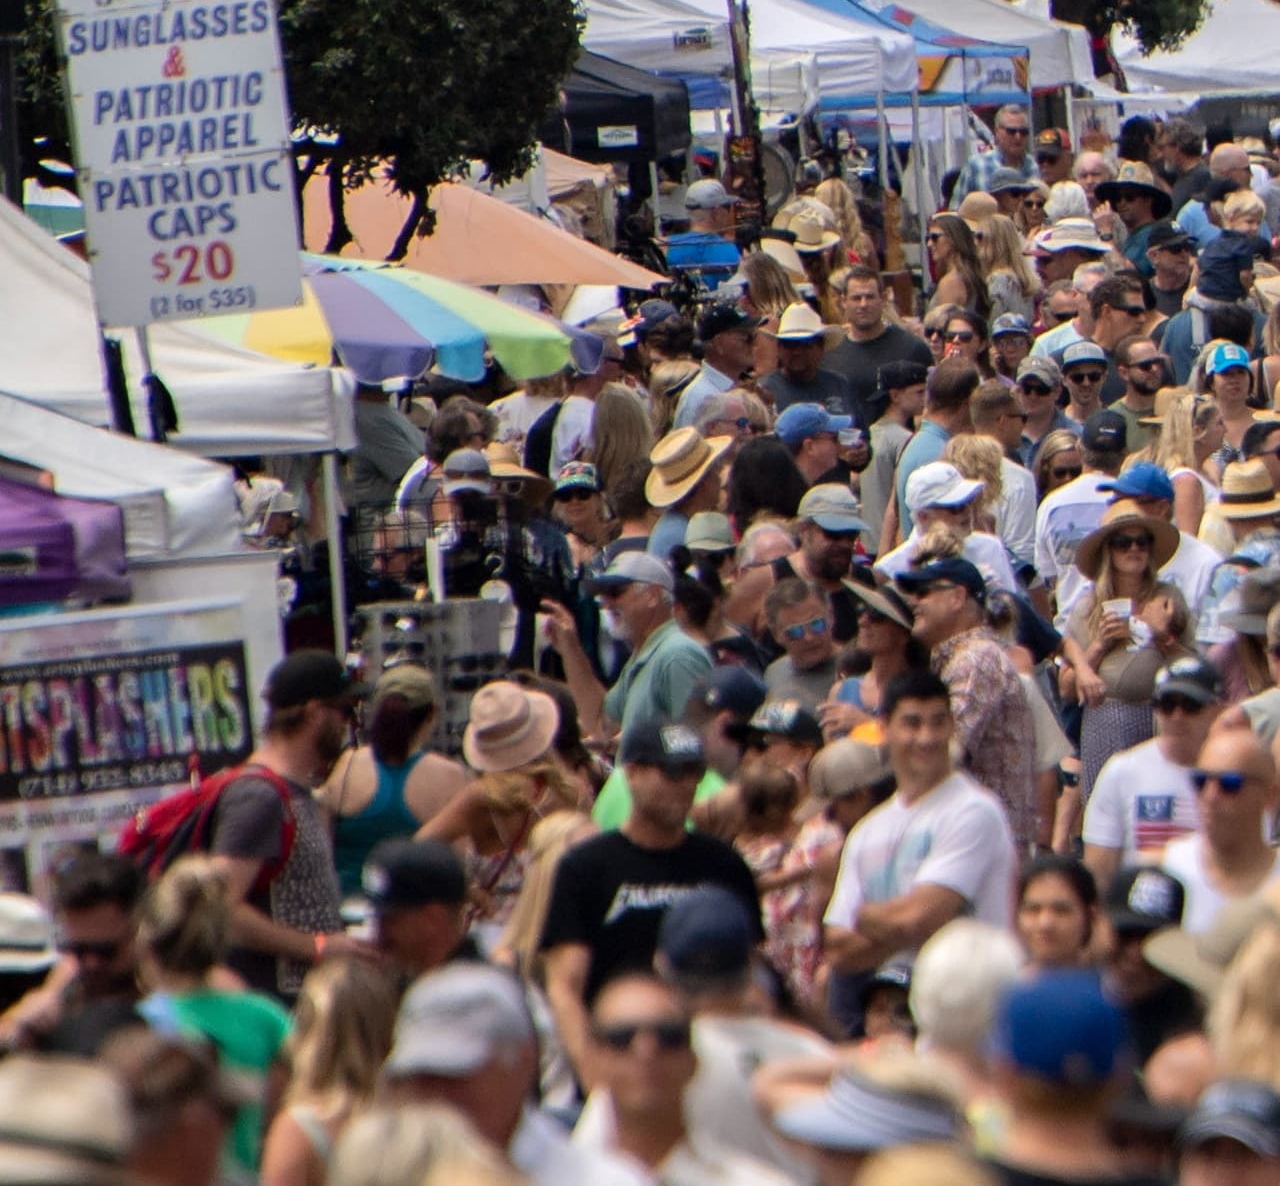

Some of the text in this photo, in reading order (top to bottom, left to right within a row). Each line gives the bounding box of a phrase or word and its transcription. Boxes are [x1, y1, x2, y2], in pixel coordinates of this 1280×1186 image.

[69, 0, 268, 55] SUNGLASSES
[162, 45, 186, 78] &
[94, 71, 263, 125] PATRIOTIC
[112, 113, 258, 163] APPAREL
[95, 160, 280, 212] PATRIOTIC
[148, 203, 237, 241] CAPS
[152, 240, 234, 285] $20
[175, 295, 203, 313] for
[0, 659, 246, 774] TSPLASHERS
